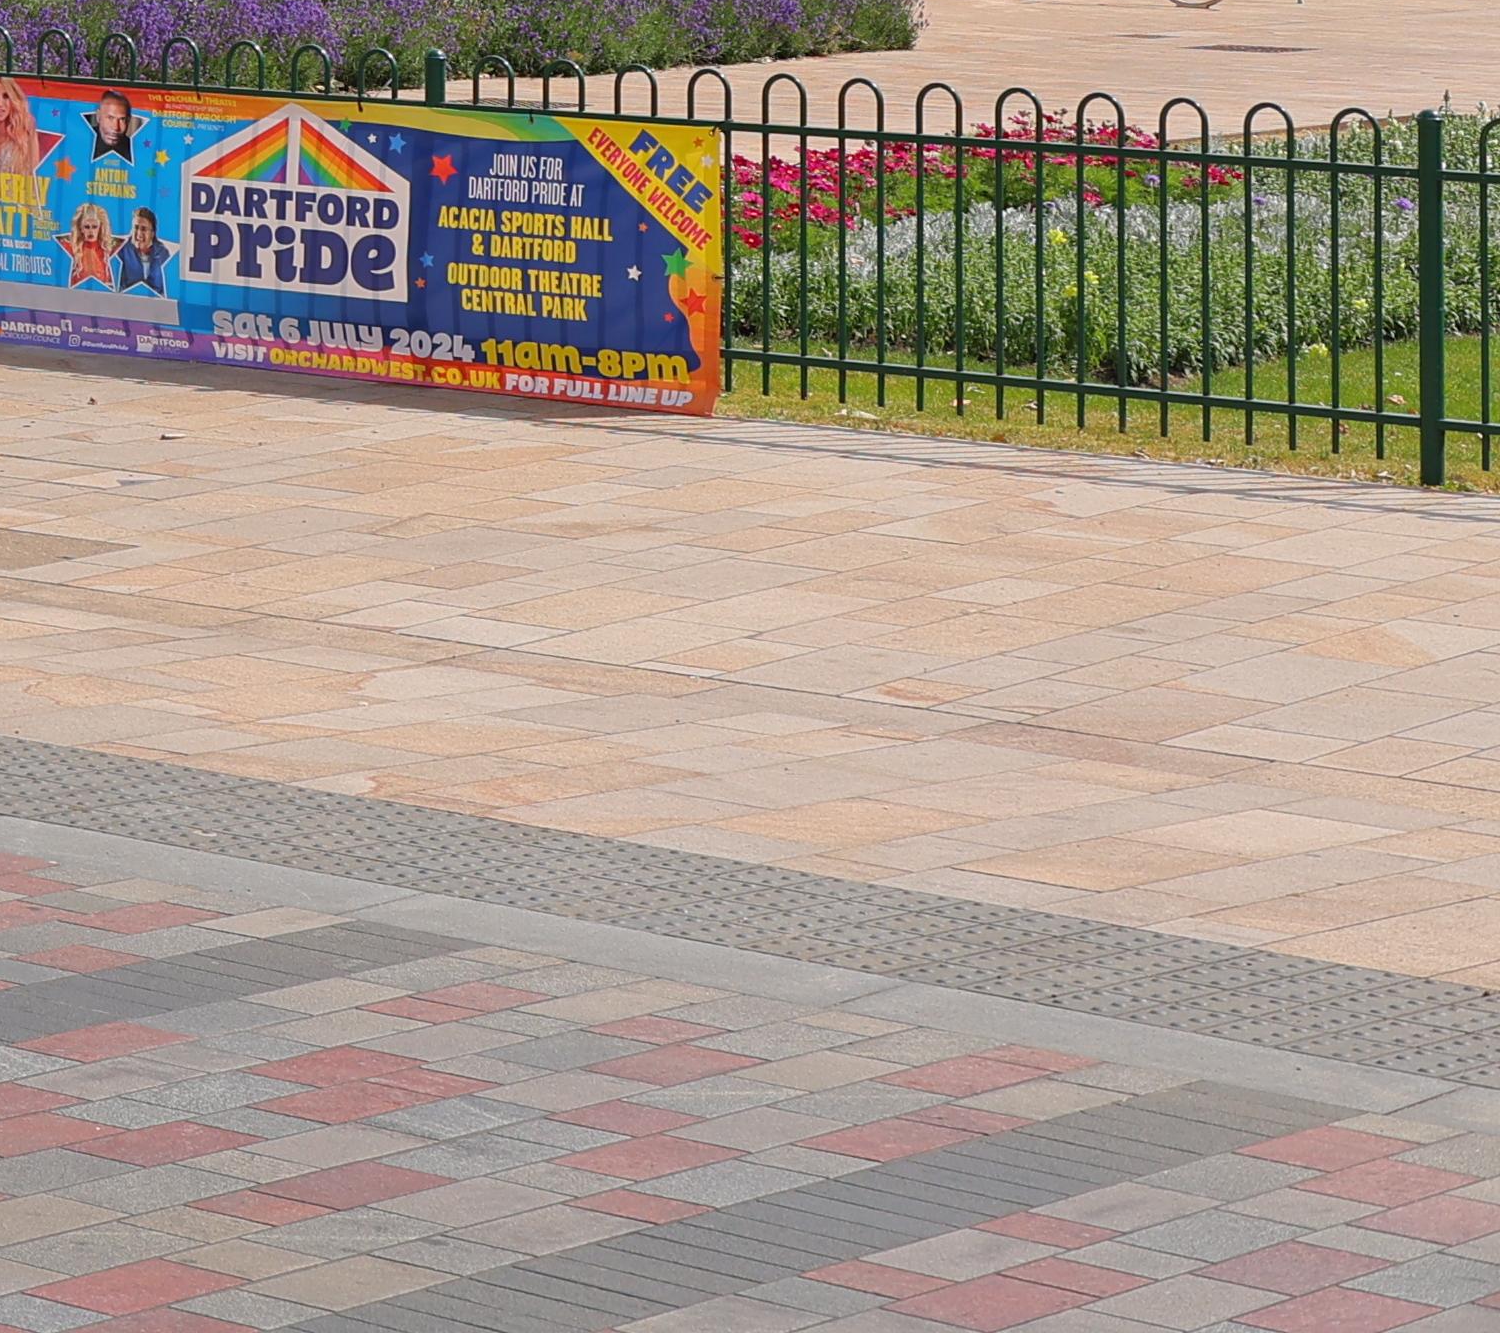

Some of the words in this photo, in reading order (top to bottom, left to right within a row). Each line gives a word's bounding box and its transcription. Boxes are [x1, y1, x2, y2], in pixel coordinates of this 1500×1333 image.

[152, 109, 193, 118] DARTFORD
[194, 113, 237, 124] BOROUGH
[489, 153, 519, 177] JOIN
[520, 157, 537, 178] US
[539, 158, 563, 181] FOR
[628, 129, 713, 214] FREE
[468, 177, 528, 203] DARTFORD
[531, 181, 567, 206] PRIDE
[570, 184, 584, 207] AT
[587, 127, 652, 195] EVERYONE
[647, 187, 713, 251] WELCOME
[191, 181, 399, 230] DARTFORD
[438, 206, 496, 232] ACACIA
[501, 210, 565, 239] SPORTS
[570, 216, 613, 242] HALL
[12, 253, 52, 276] TRIBUTES
[471, 233, 484, 256] &
[491, 235, 577, 264] DARTFORD
[447, 263, 523, 292] OUTDOOR
[527, 270, 602, 298] THEATRE
[461, 288, 537, 317] CENTRAL
[542, 296, 588, 321] PARK
[1, 321, 62, 337] DARTFORD
[1, 332, 31, 341] BOROUGH
[139, 335, 190, 349] DARTFORD
[279, 318, 301, 344] 6
[390, 328, 475, 363] 2024
[212, 340, 267, 363] VISIT
[269, 347, 501, 389] ORCHARDWEST.CO.UK
[505, 373, 550, 394] FOR
[552, 378, 604, 399] FULL
[608, 384, 657, 405] LINE
[660, 389, 693, 407] UP
